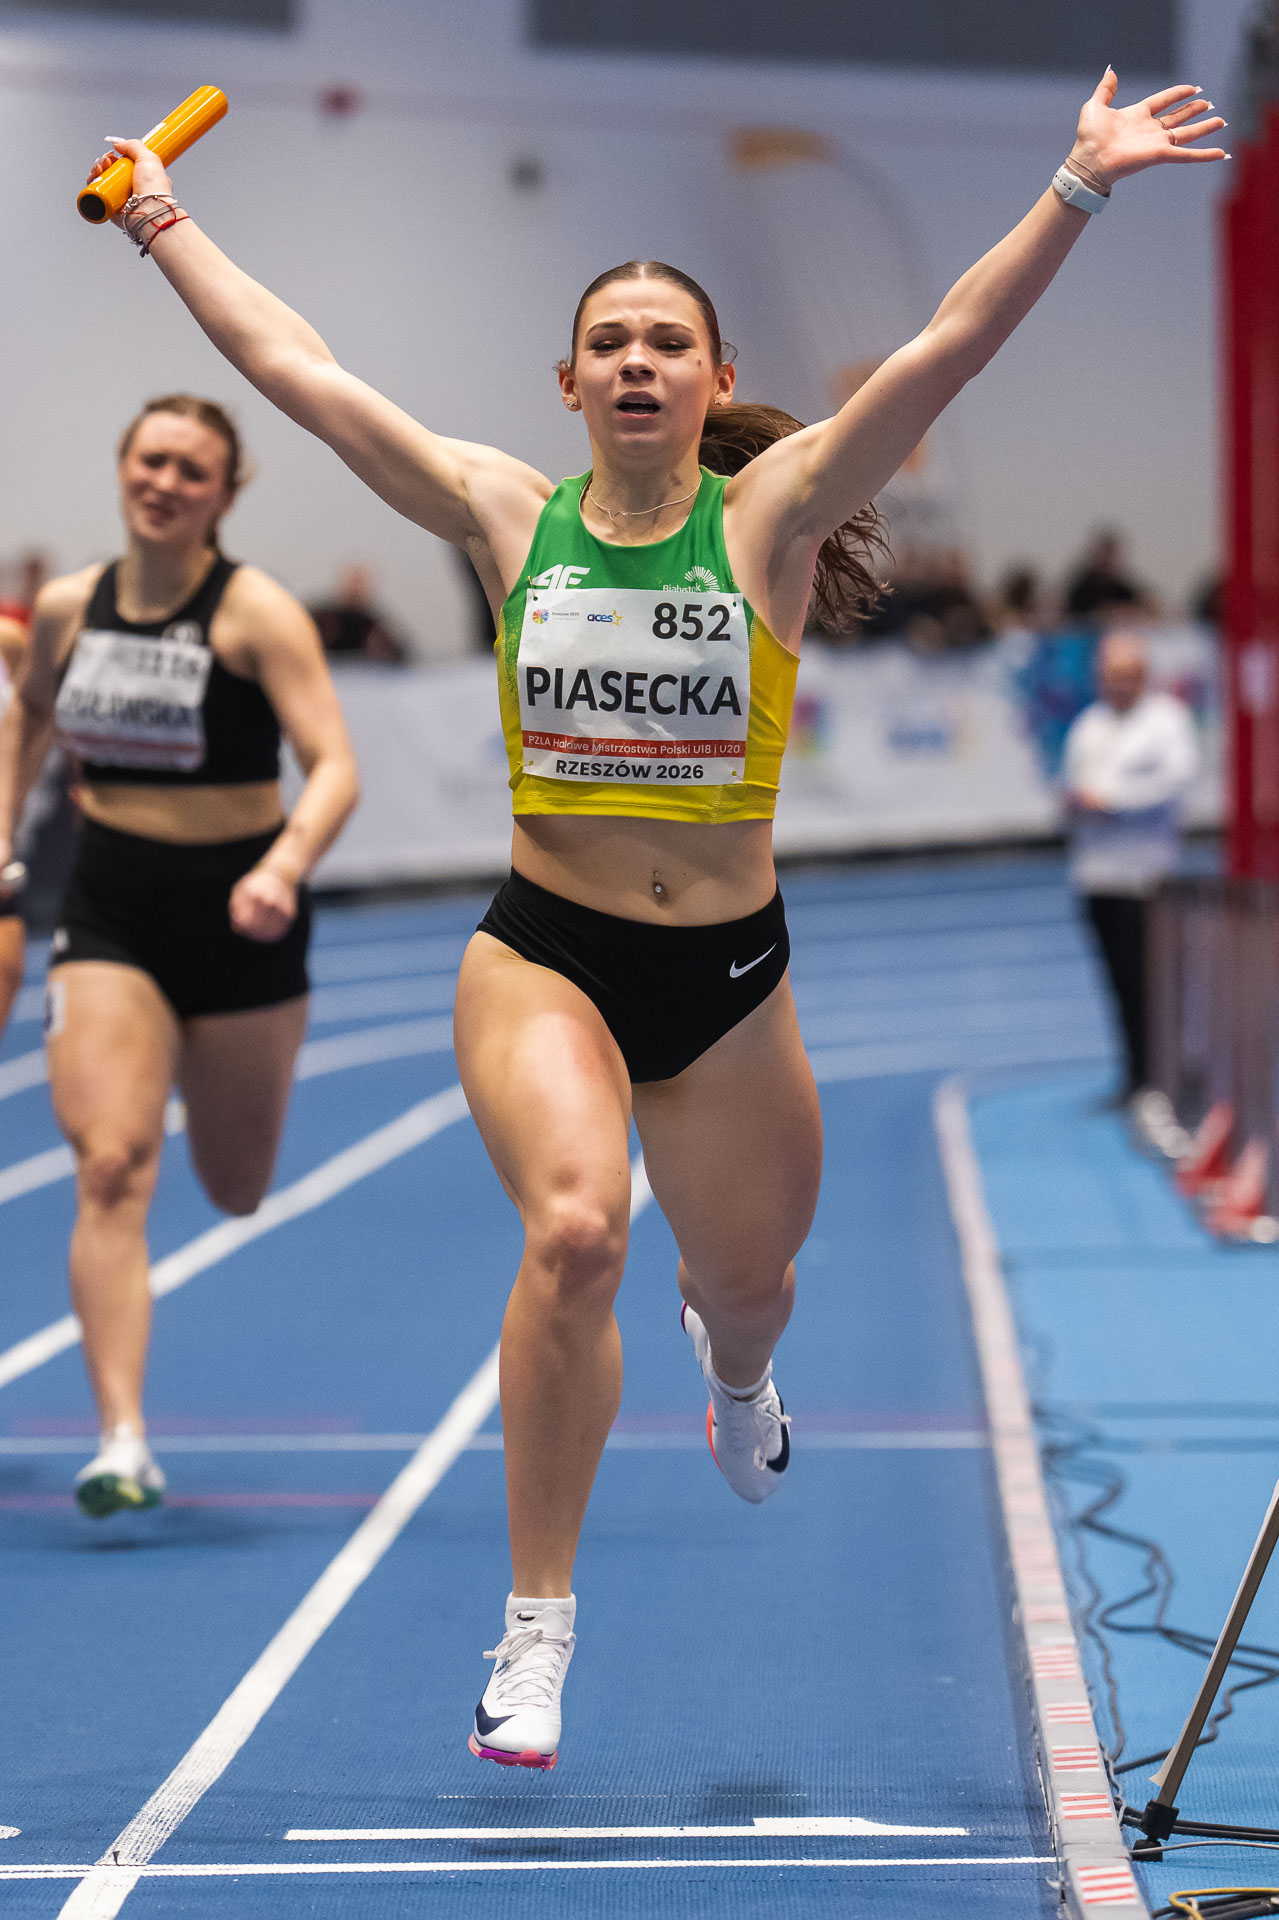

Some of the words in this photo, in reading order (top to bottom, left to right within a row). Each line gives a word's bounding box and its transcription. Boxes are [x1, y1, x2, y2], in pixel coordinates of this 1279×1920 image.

[587, 613, 613, 623] aces
[652, 602, 730, 641] 852
[526, 666, 742, 716] PIASECKA
[528, 735, 550, 746] PZLA
[553, 739, 589, 751] Halowe
[592, 742, 657, 754] Mistrzostwa
[660, 745, 690, 754] Polski
[693, 745, 711, 754] U18
[720, 745, 739, 753] U20
[556, 760, 652, 779] RZESZÓW
[656, 764, 704, 779] 2026
